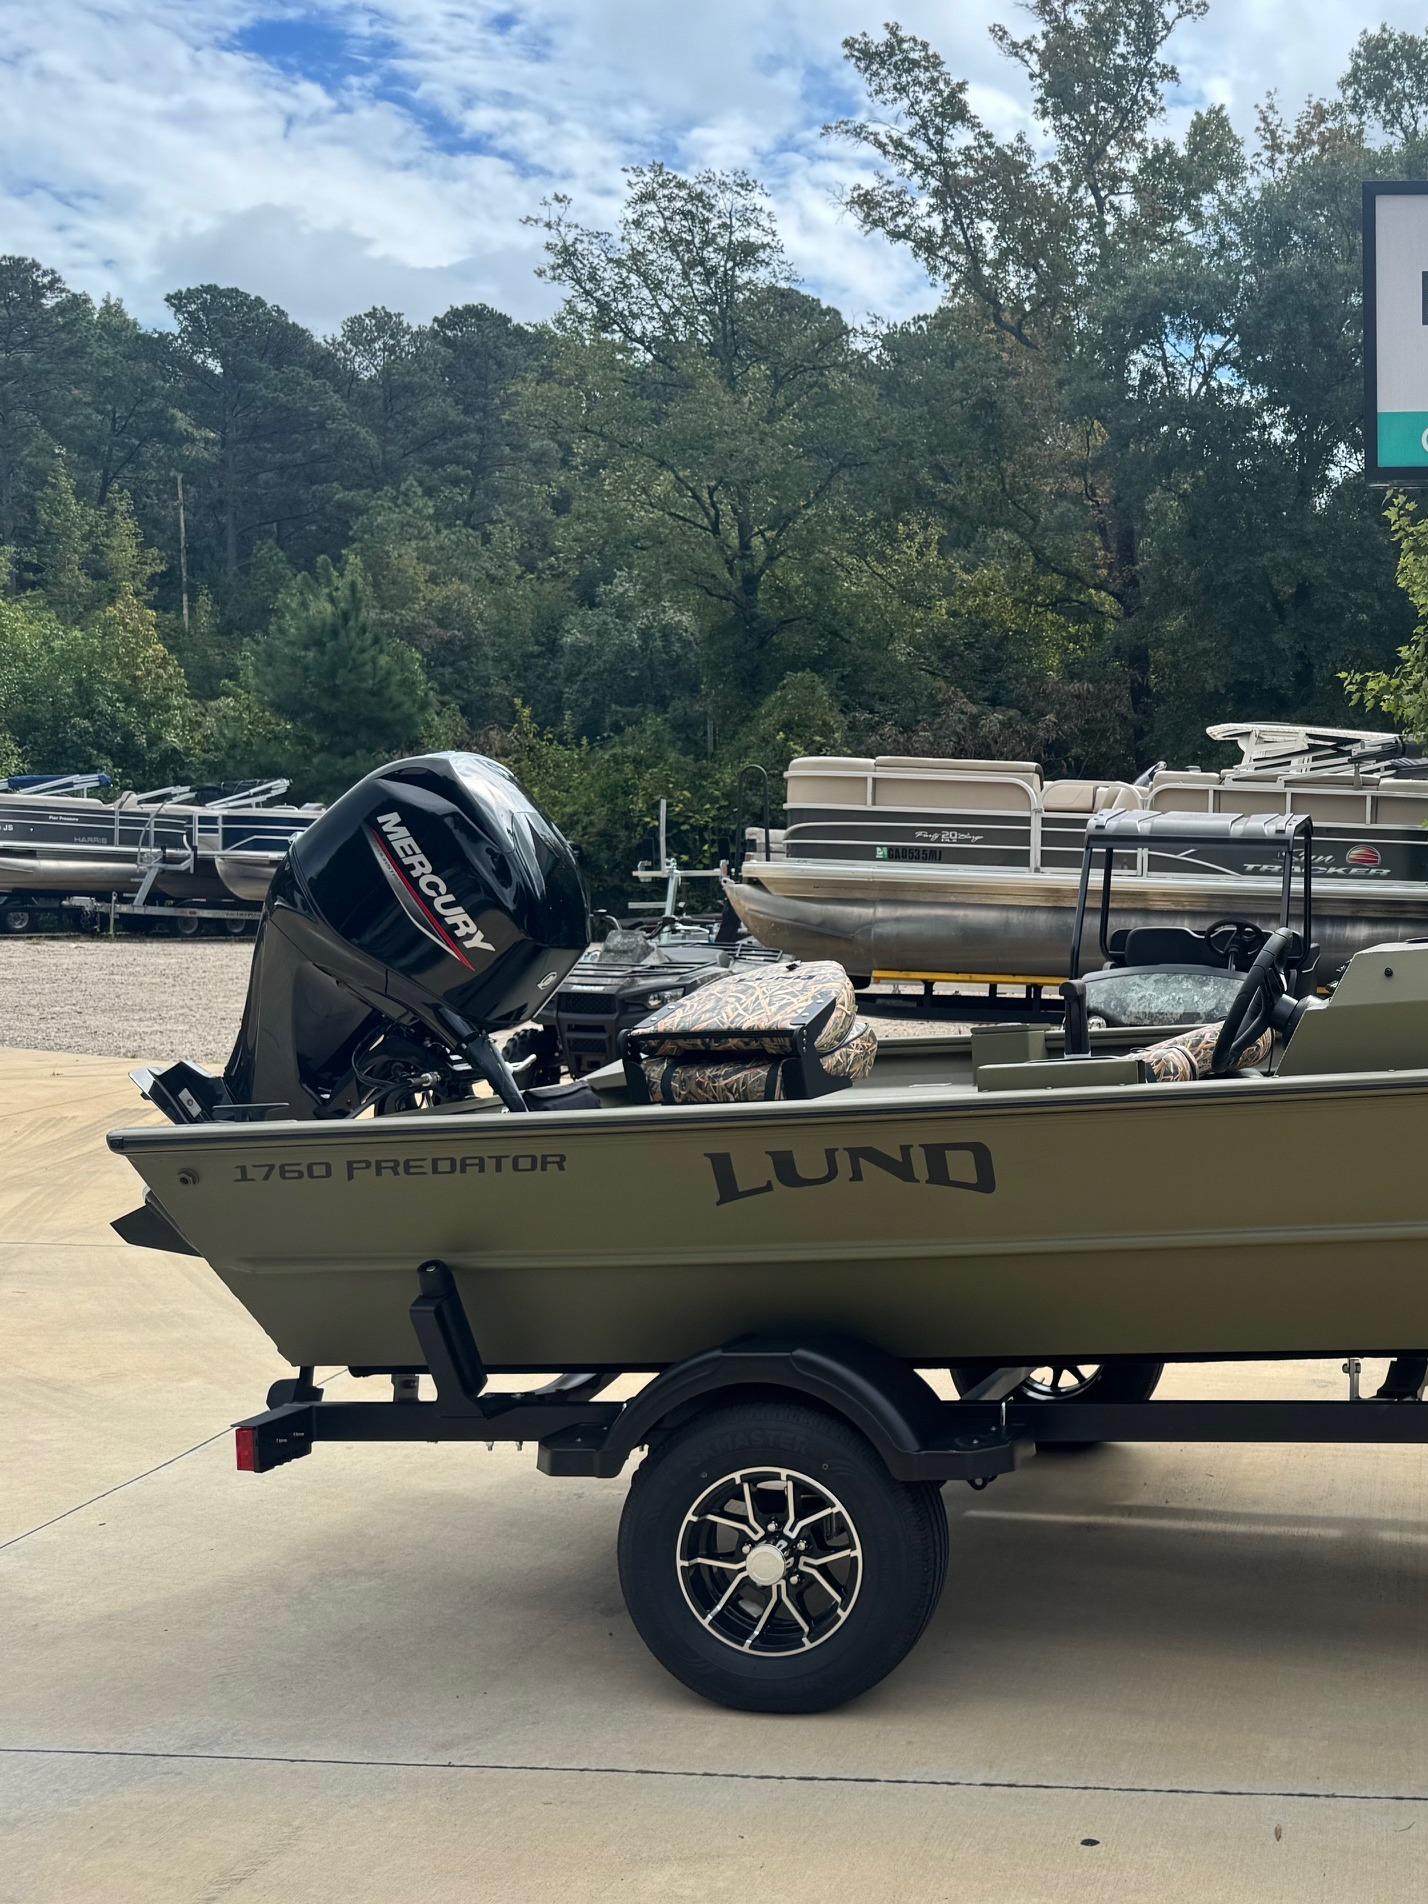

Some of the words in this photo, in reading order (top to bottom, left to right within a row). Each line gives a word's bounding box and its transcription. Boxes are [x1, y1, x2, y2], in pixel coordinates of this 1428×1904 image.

[73, 836, 108, 845] HARRIS
[941, 830, 958, 840] 20
[376, 811, 496, 952] MERCURY
[232, 1160, 333, 1183] 1760
[346, 1153, 567, 1182] PREDATOR
[703, 1141, 997, 1207] LUND
